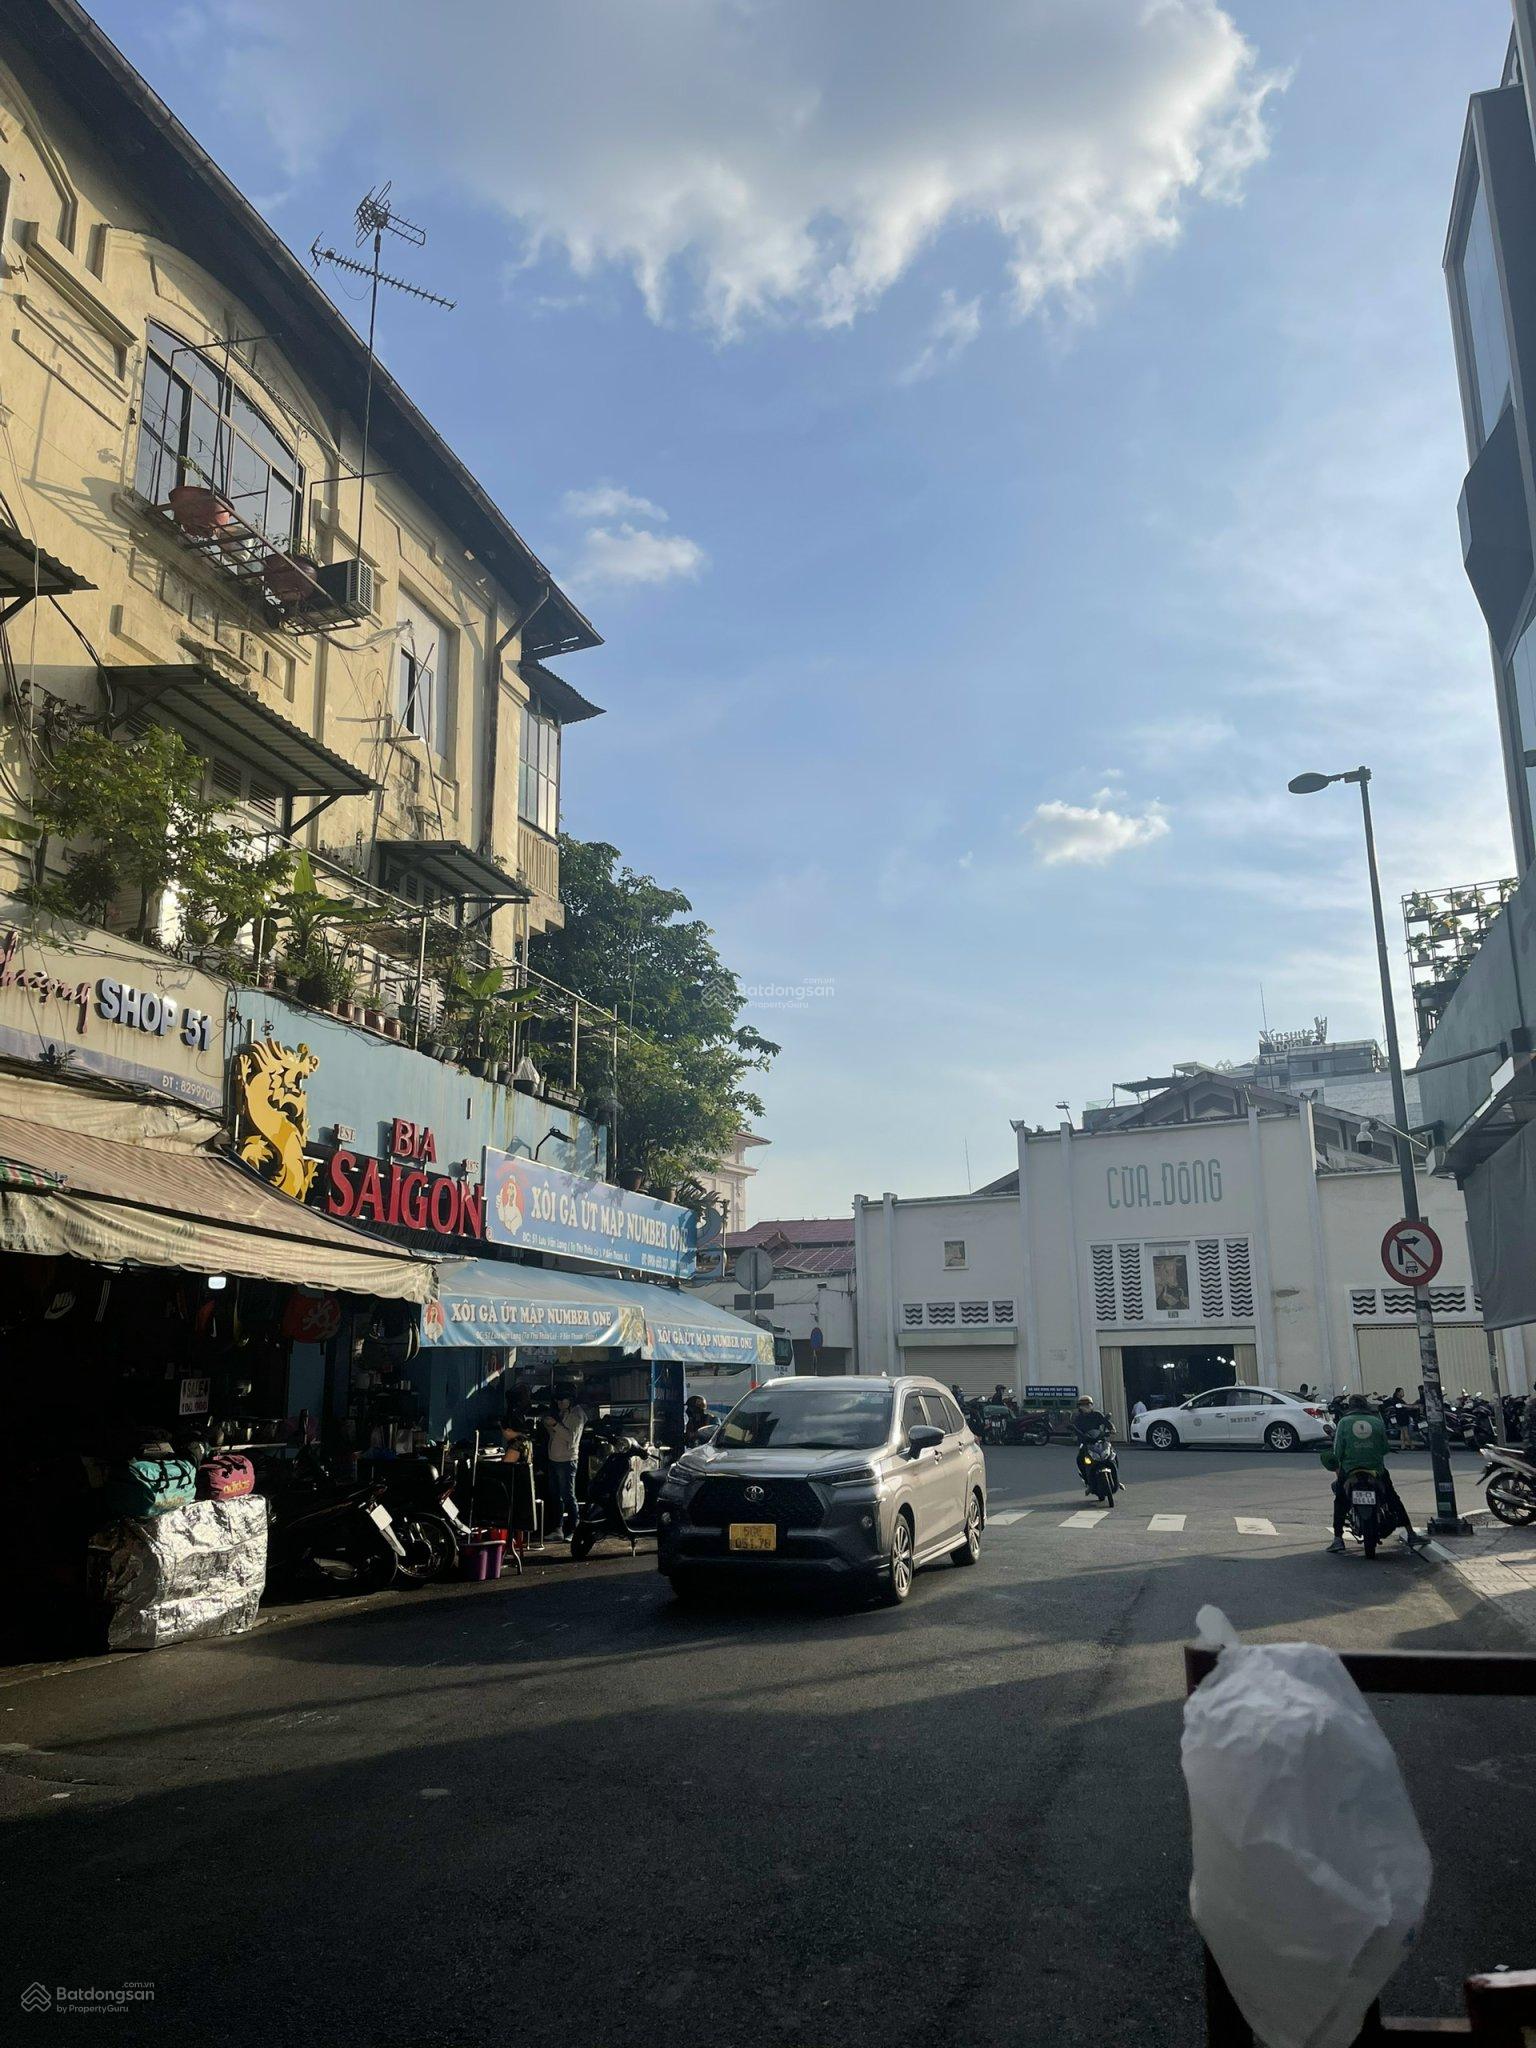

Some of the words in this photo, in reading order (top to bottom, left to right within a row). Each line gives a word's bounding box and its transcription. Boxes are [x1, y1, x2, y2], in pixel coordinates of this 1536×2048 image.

[97, 977, 178, 1036] SHOP
[183, 1008, 212, 1051] 51
[393, 1118, 437, 1163] BIA
[329, 1150, 484, 1239] SAIGON
[531, 1180, 556, 1222] XÔI
[560, 1188, 578, 1228] GÀ
[582, 1193, 598, 1232] ÚT
[628, 1213, 668, 1250] NUMBER
[670, 1226, 689, 1253] ONE
[451, 1299, 476, 1322] XÔI
[479, 1301, 498, 1323] GÀ
[501, 1302, 518, 1324] ÚT
[520, 1303, 545, 1327] MẬP
[548, 1308, 591, 1326] NUMBER
[593, 1311, 613, 1327] ONE
[657, 1326, 671, 1344] XÔI
[712, 1334, 740, 1349] NUMBER
[740, 1337, 753, 1349] ONE
